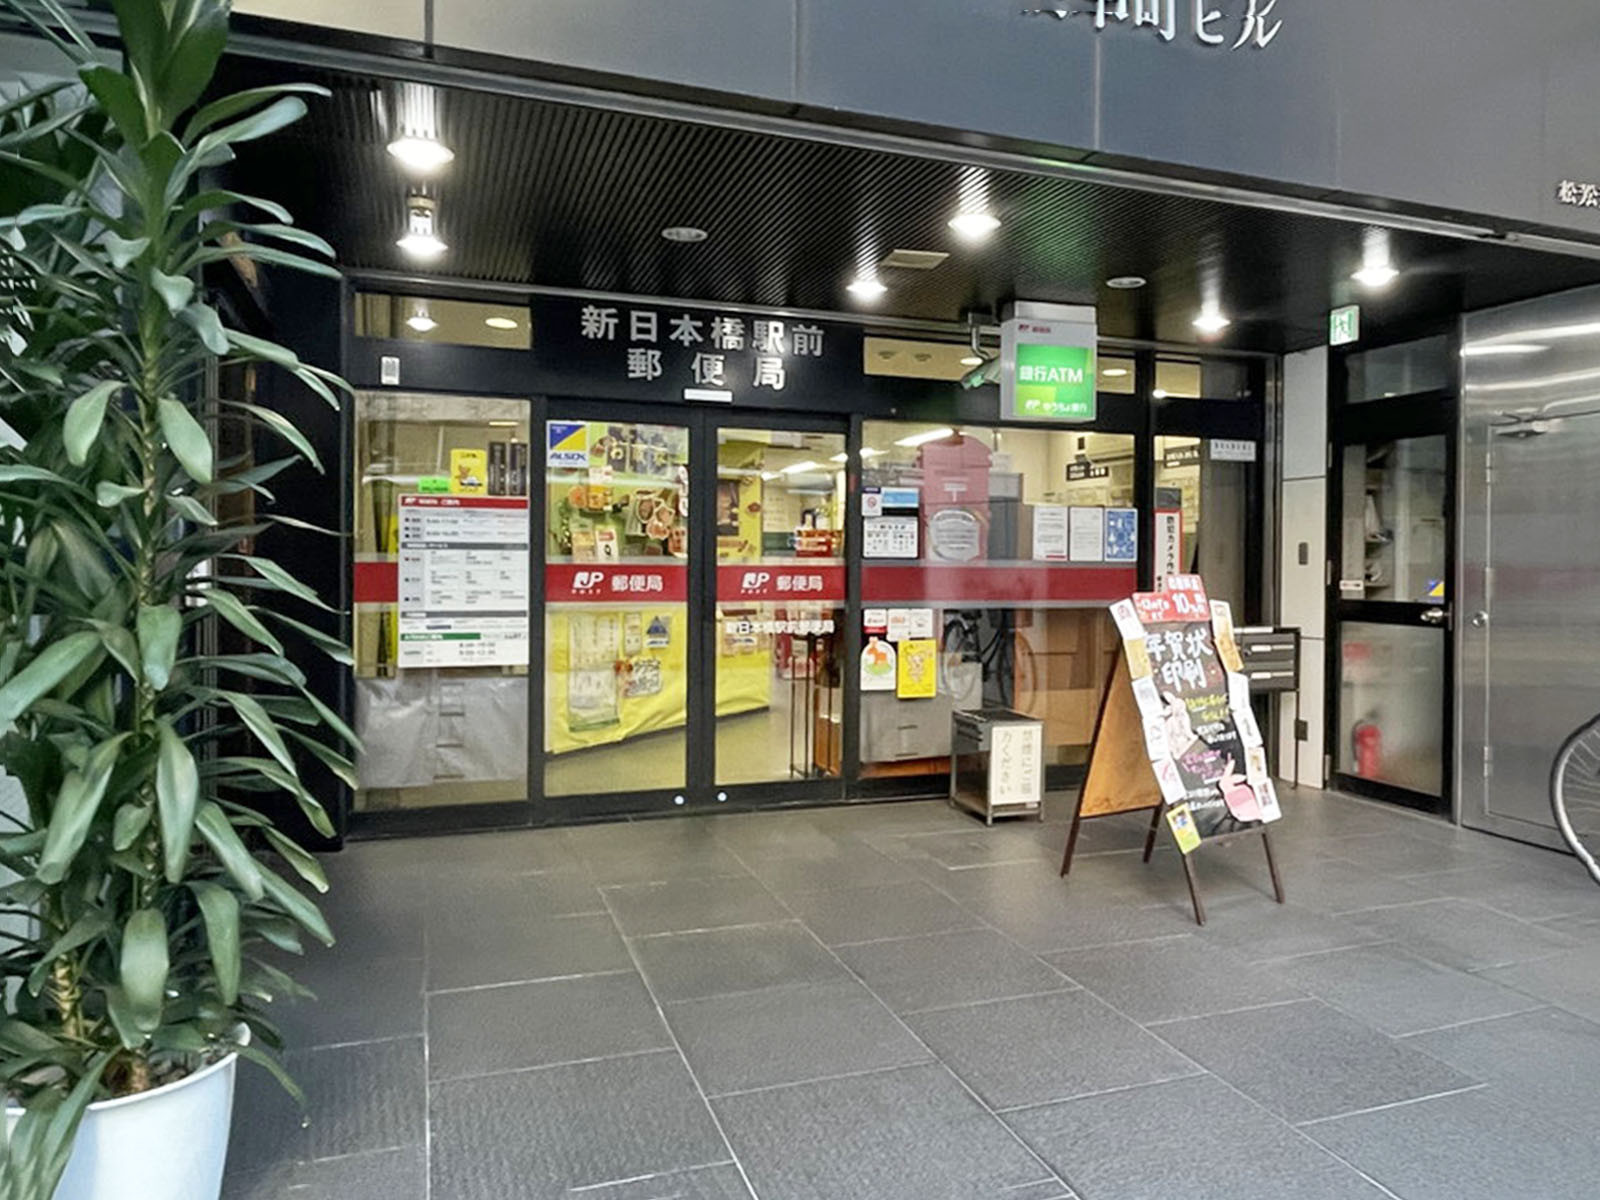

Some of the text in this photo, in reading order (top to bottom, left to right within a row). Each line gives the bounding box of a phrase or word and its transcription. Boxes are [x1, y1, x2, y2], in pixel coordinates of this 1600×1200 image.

[581, 304, 825, 357] 新日本橋駅前
[627, 348, 786, 390] 郵便局
[612, 574, 664, 592] 郵便局
[776, 575, 823, 592] 郵便局
[1147, 628, 1213, 661] 年賀状
